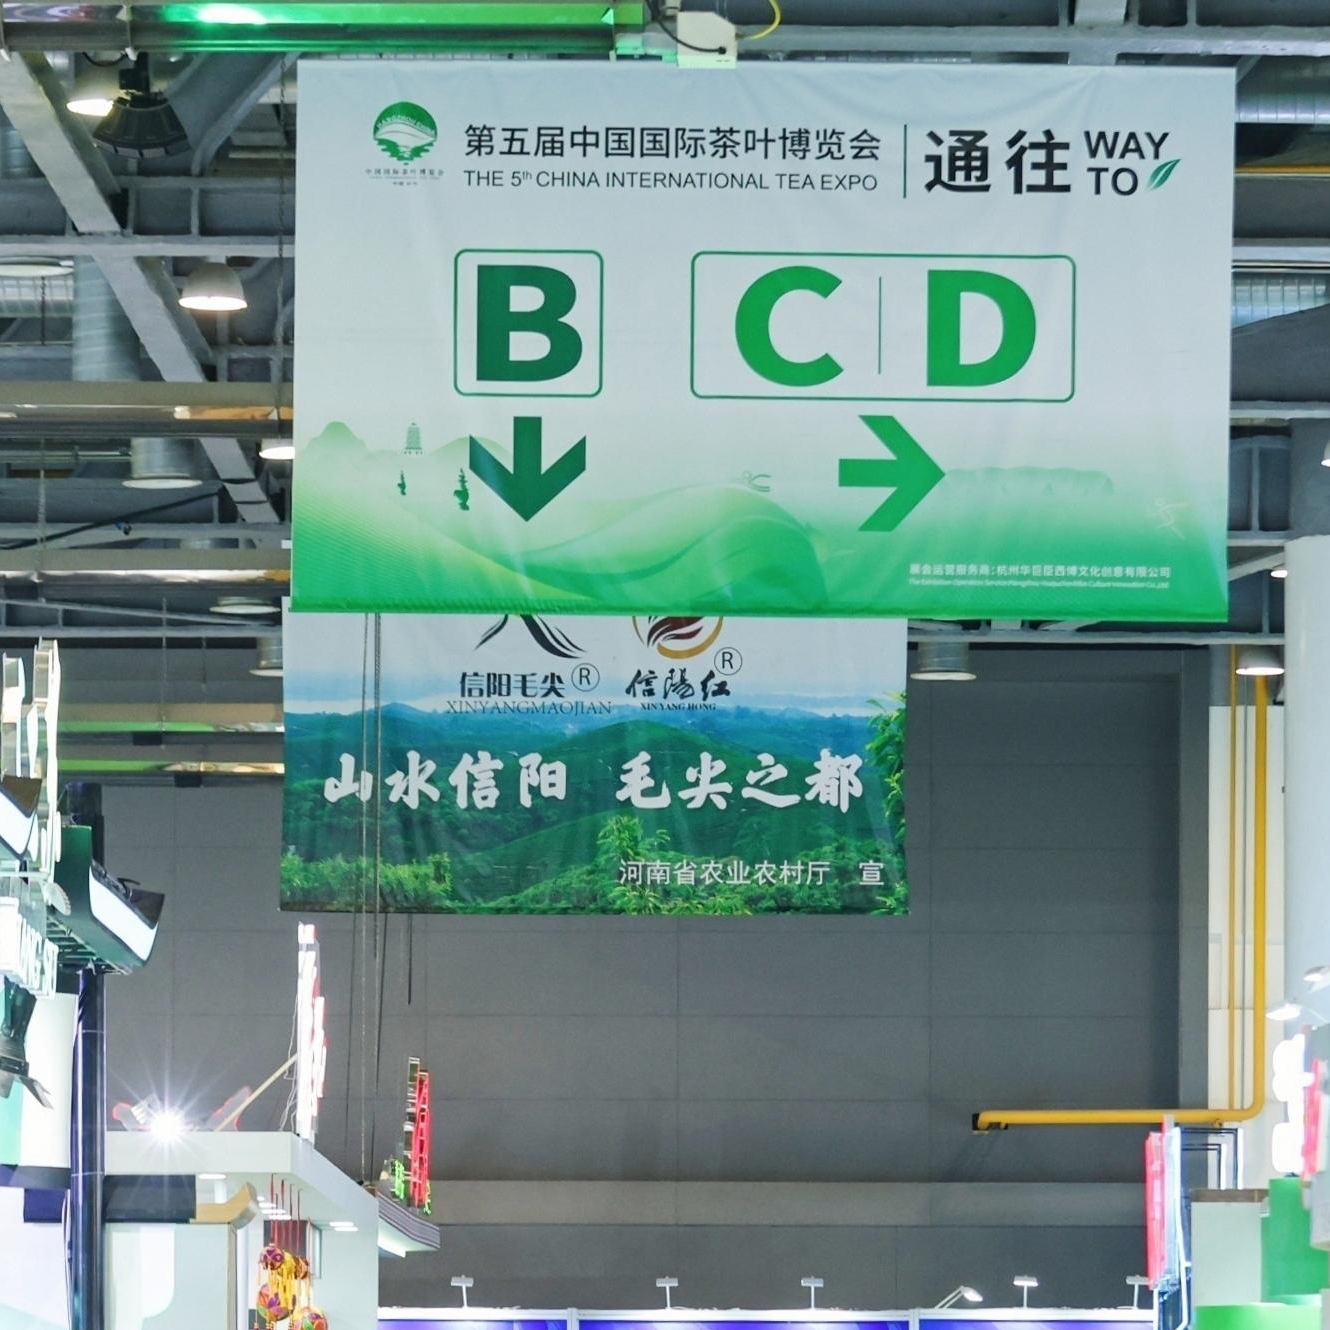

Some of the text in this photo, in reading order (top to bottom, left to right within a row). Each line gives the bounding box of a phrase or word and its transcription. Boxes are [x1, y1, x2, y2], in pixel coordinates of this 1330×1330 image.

[464, 124, 881, 160] 第五届中国国际茶叶博览会
[1084, 130, 1170, 161] WAY
[923, 128, 1072, 197] 通往
[464, 170, 504, 187] THE
[536, 171, 600, 188] CHINA
[606, 171, 769, 189] INTERNATIONAL
[775, 173, 815, 190] TEA
[820, 174, 878, 191] EXPO
[1086, 167, 1139, 196] TO
[475, 264, 583, 383] B
[735, 265, 1038, 387] C D
[460, 671, 564, 698] 信阳毛尖
[447, 700, 613, 715] XINYANGMAOJIAN
[324, 749, 864, 813] 山水信阳 毛尖之都
[619, 858, 885, 886] 河南省农业农村厅 宣
